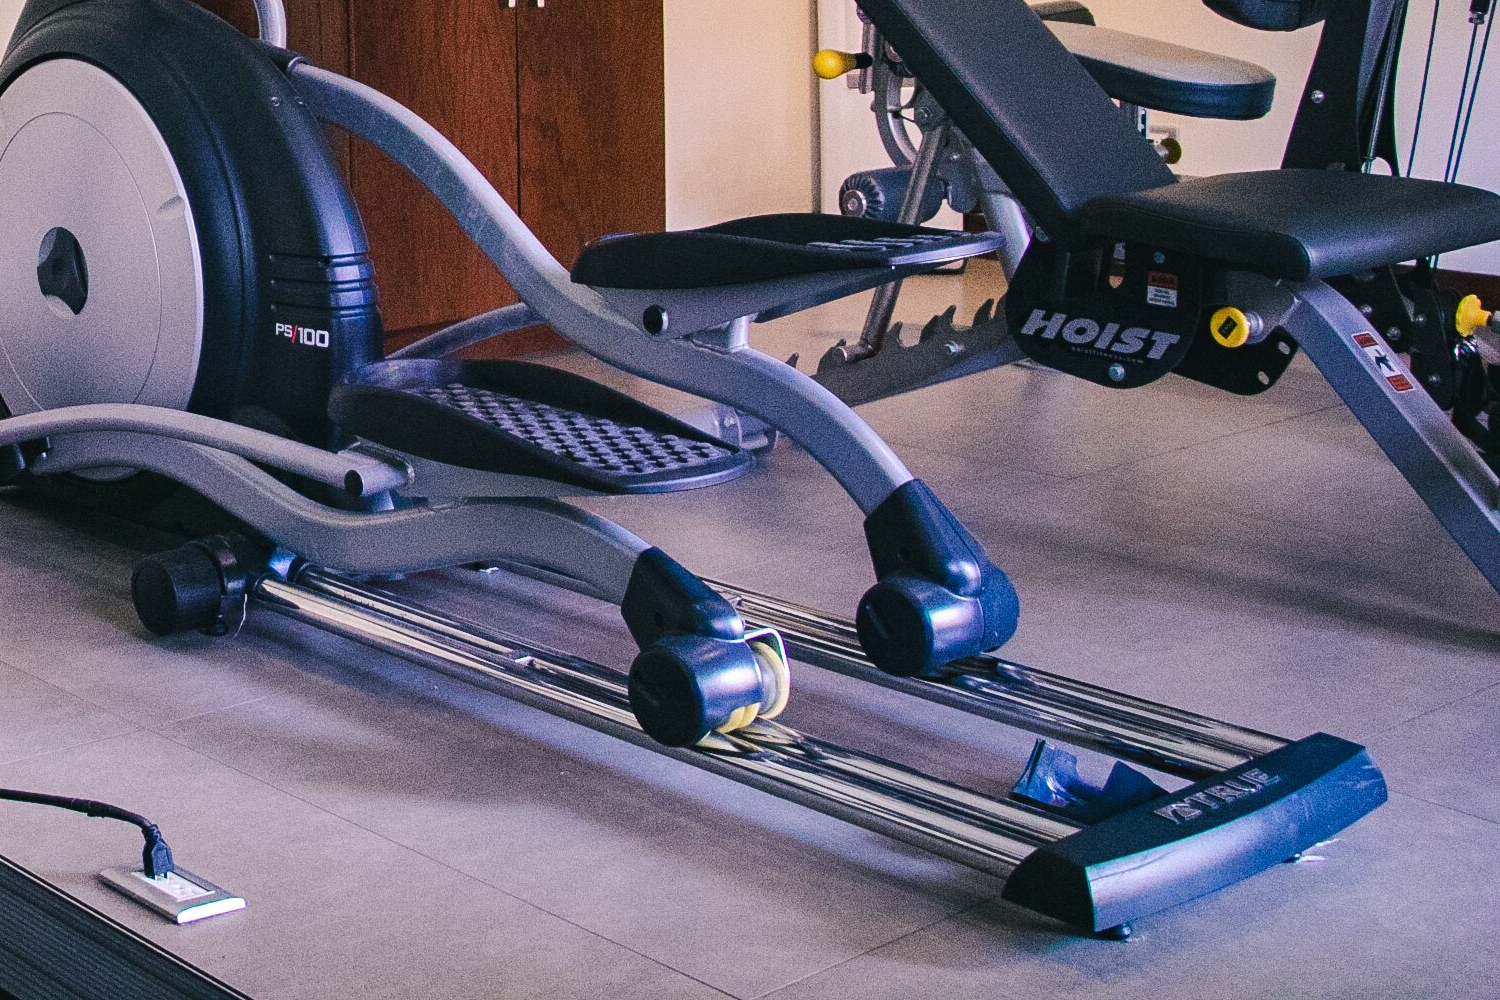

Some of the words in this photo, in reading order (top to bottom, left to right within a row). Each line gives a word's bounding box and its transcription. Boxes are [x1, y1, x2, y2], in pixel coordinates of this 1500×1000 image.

[276, 322, 330, 348] PS/100
[1021, 308, 1181, 360] HOIST
[1183, 768, 1281, 810] TRUE
